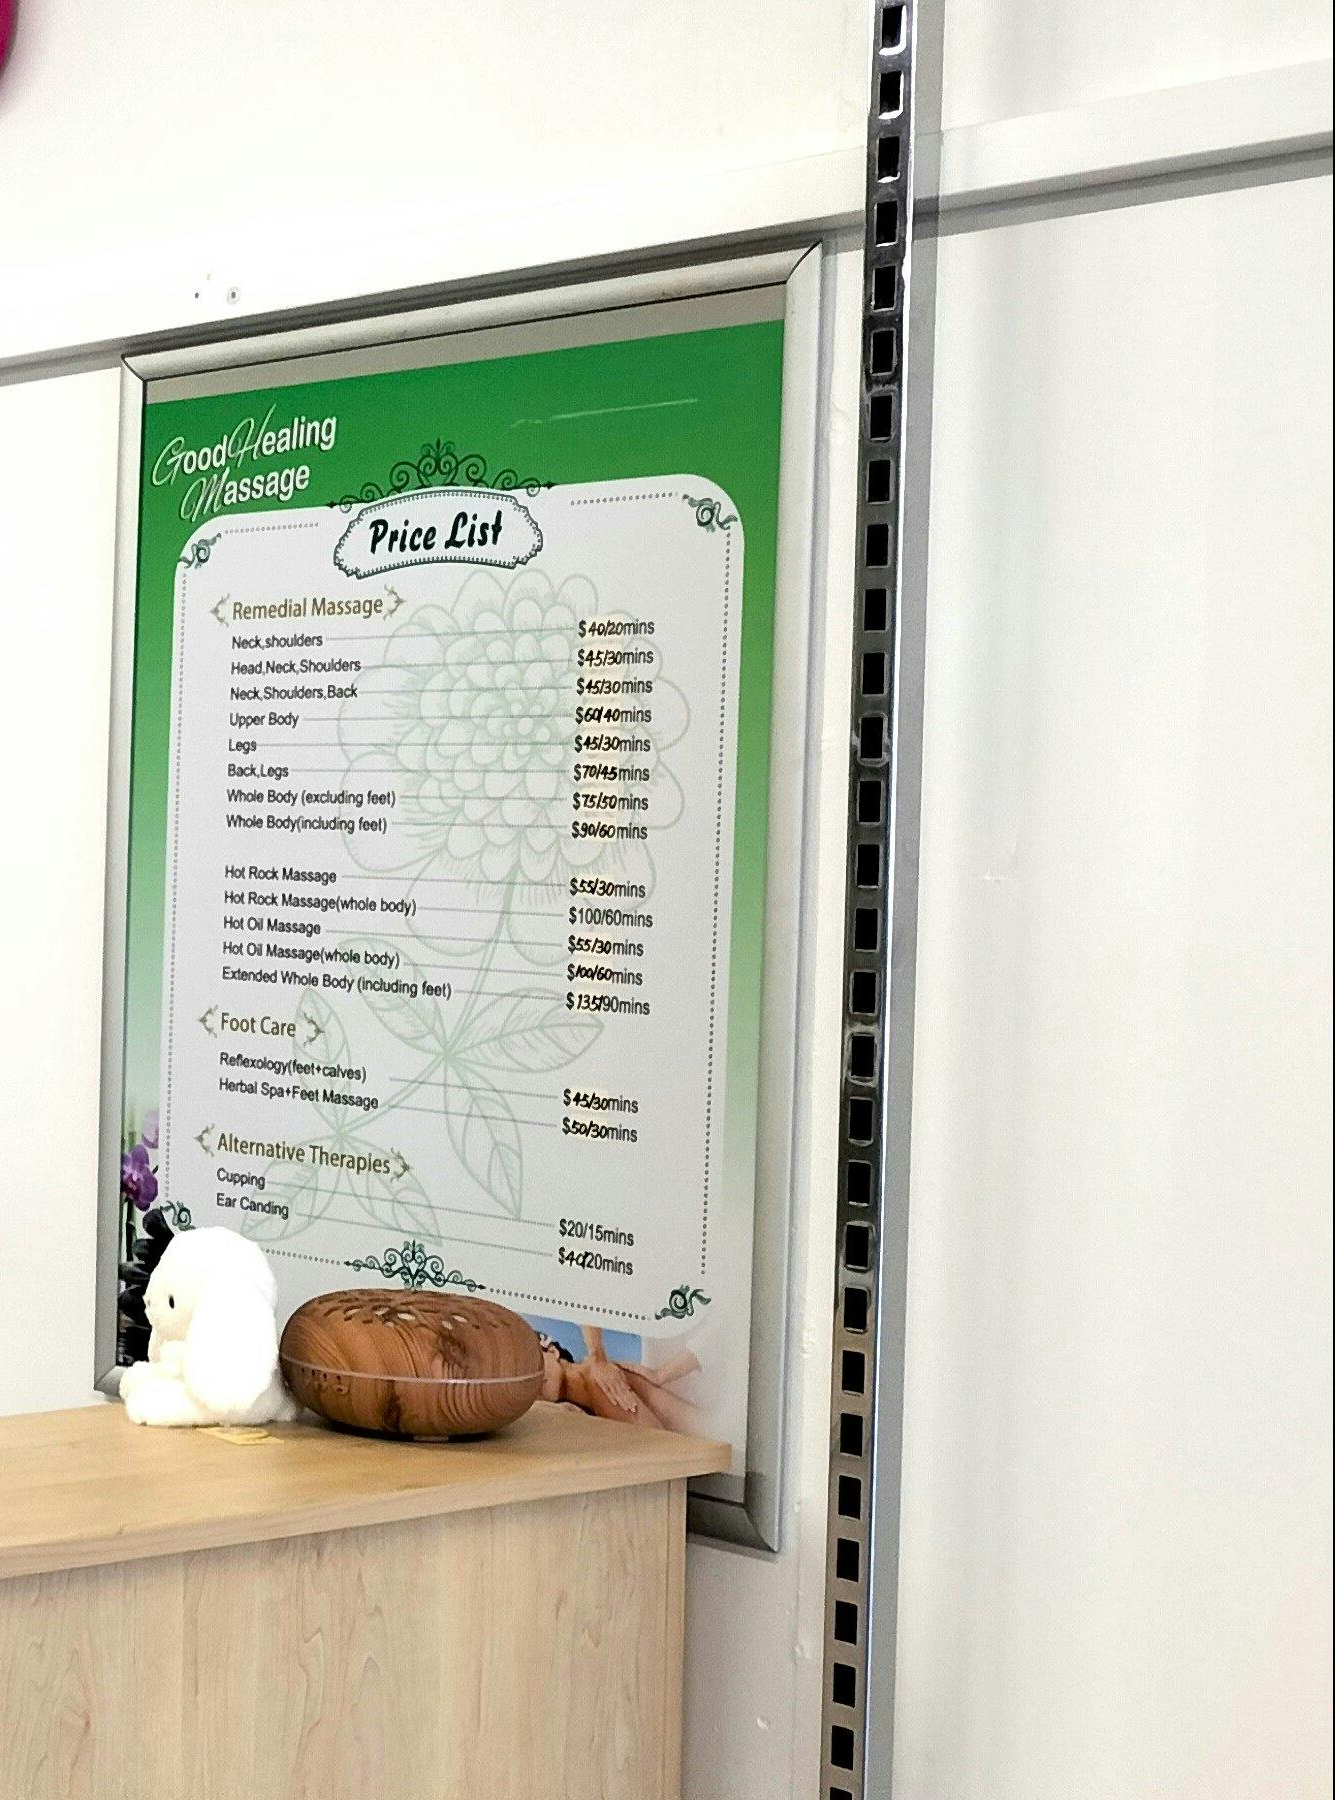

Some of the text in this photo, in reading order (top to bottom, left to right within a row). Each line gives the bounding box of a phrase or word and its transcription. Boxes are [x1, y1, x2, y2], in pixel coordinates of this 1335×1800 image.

[152, 404, 337, 486] Good Healing
[180, 465, 310, 522] Massage
[369, 510, 502, 554] Price List
[232, 597, 383, 620] Remedial Massage
[229, 713, 265, 729] Upper
[268, 712, 299, 728] Body
[228, 739, 257, 754] Legs
[226, 789, 264, 803] Whole
[267, 789, 298, 806] Body
[301, 790, 363, 808] (excluding
[367, 790, 396, 808] feet)
[226, 814, 263, 828] Whole
[358, 817, 387, 834] feet)
[224, 865, 245, 879] Hot
[249, 866, 279, 881] Rock
[282, 867, 337, 886] Massage
[224, 890, 245, 905] Hot
[248, 891, 278, 907] Rock
[381, 897, 417, 917] body)
[569, 906, 653, 928] $100/60mins
[223, 916, 244, 930] Hot
[247, 917, 263, 931] Oil
[267, 918, 321, 938] Massage
[223, 942, 243, 956] Hot
[246, 942, 262, 957] Oil
[364, 950, 400, 969] body)
[222, 966, 277, 984] Extended
[281, 971, 319, 987] Whole
[322, 974, 354, 993] Body
[357, 976, 418, 998] (including
[422, 981, 452, 1001] feet)
[221, 1012, 296, 1037] Foot Care
[219, 1077, 258, 1094] Herbal
[261, 1081, 319, 1103] Spa+Feet
[322, 1089, 379, 1111] Massage
[217, 1133, 391, 1175] Alternative Therapies
[217, 1167, 634, 1246] Cupping $20/15mins
[217, 1193, 237, 1207] Ear
[240, 1196, 289, 1220] Canding
